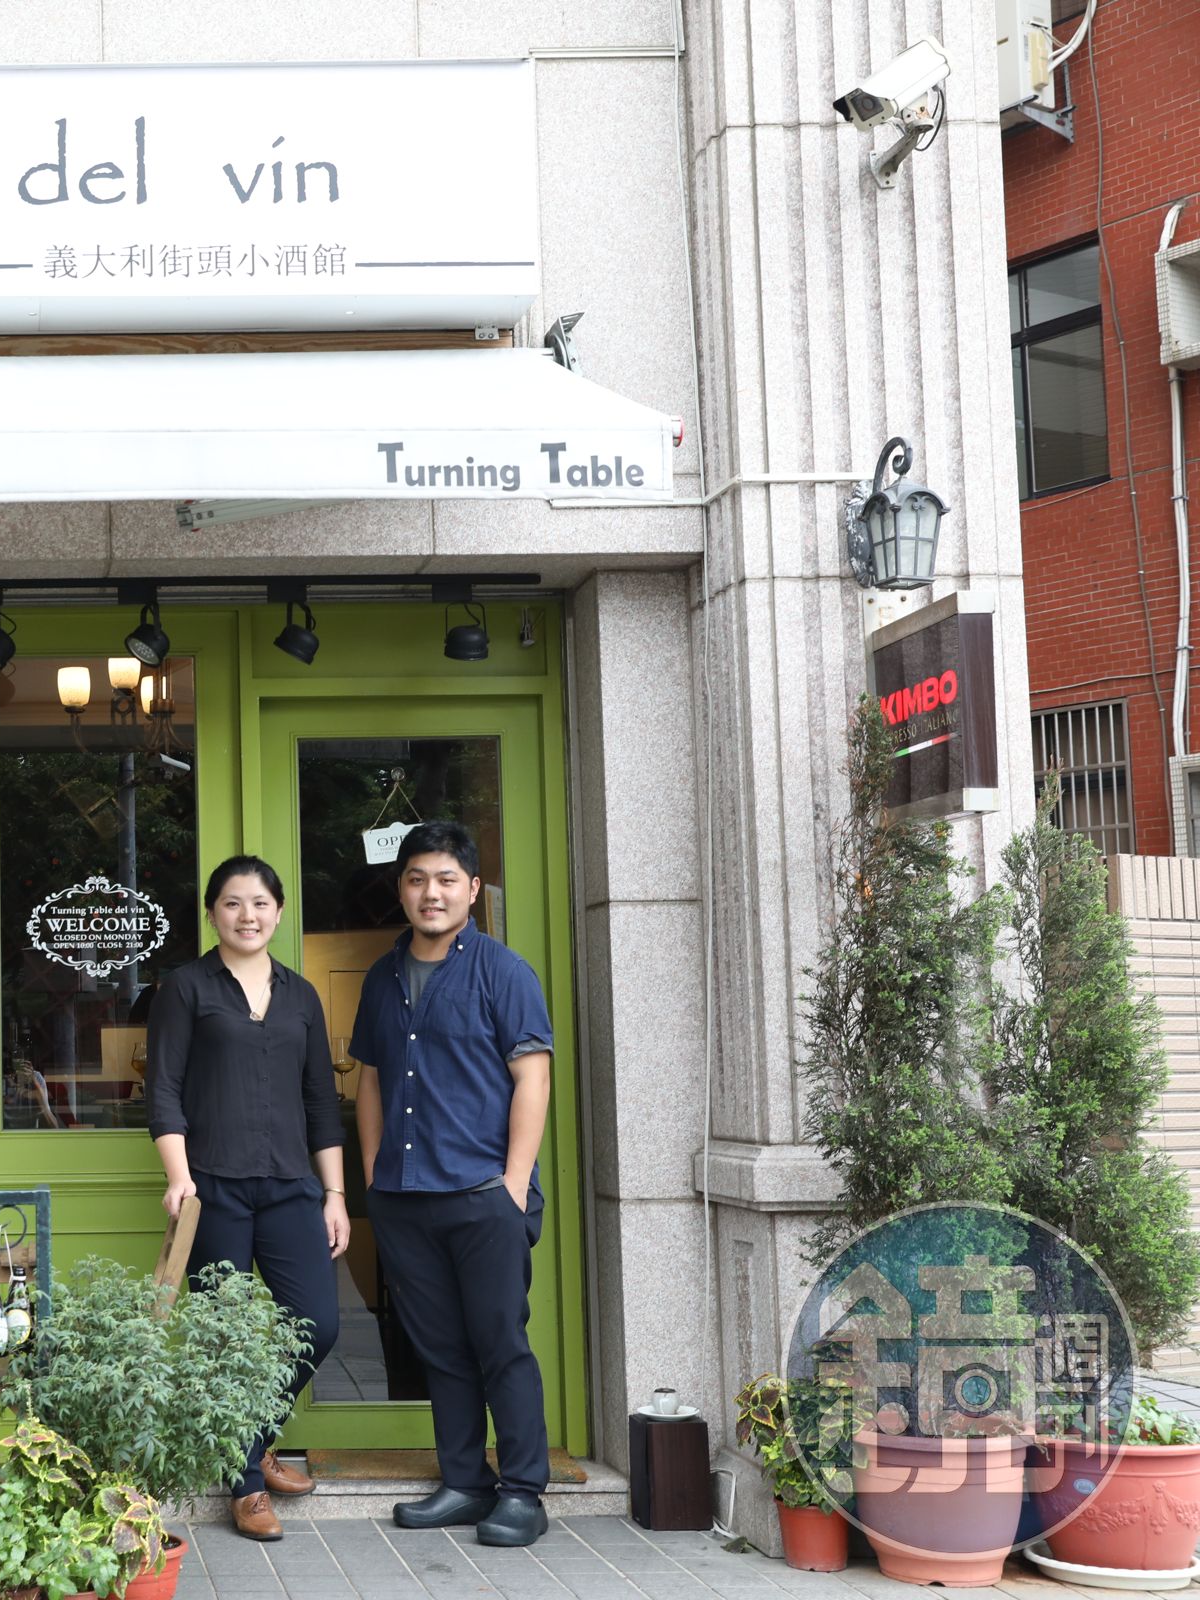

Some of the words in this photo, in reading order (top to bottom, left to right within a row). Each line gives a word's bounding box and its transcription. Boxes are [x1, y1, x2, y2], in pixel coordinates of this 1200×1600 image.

[17, 116, 148, 206] del
[222, 135, 340, 204] vin
[42, 243, 349, 280] 義大利街頭小酒館
[377, 441, 522, 492] Turning
[540, 441, 645, 488] Table
[880, 669, 958, 727] KIMBO
[46, 917, 151, 933] WELCOME
[51, 906, 87, 916] Turning
[88, 905, 113, 915] Table
[114, 905, 128, 915] del
[130, 905, 145, 914] vin
[103, 933, 143, 941] MONDAY
